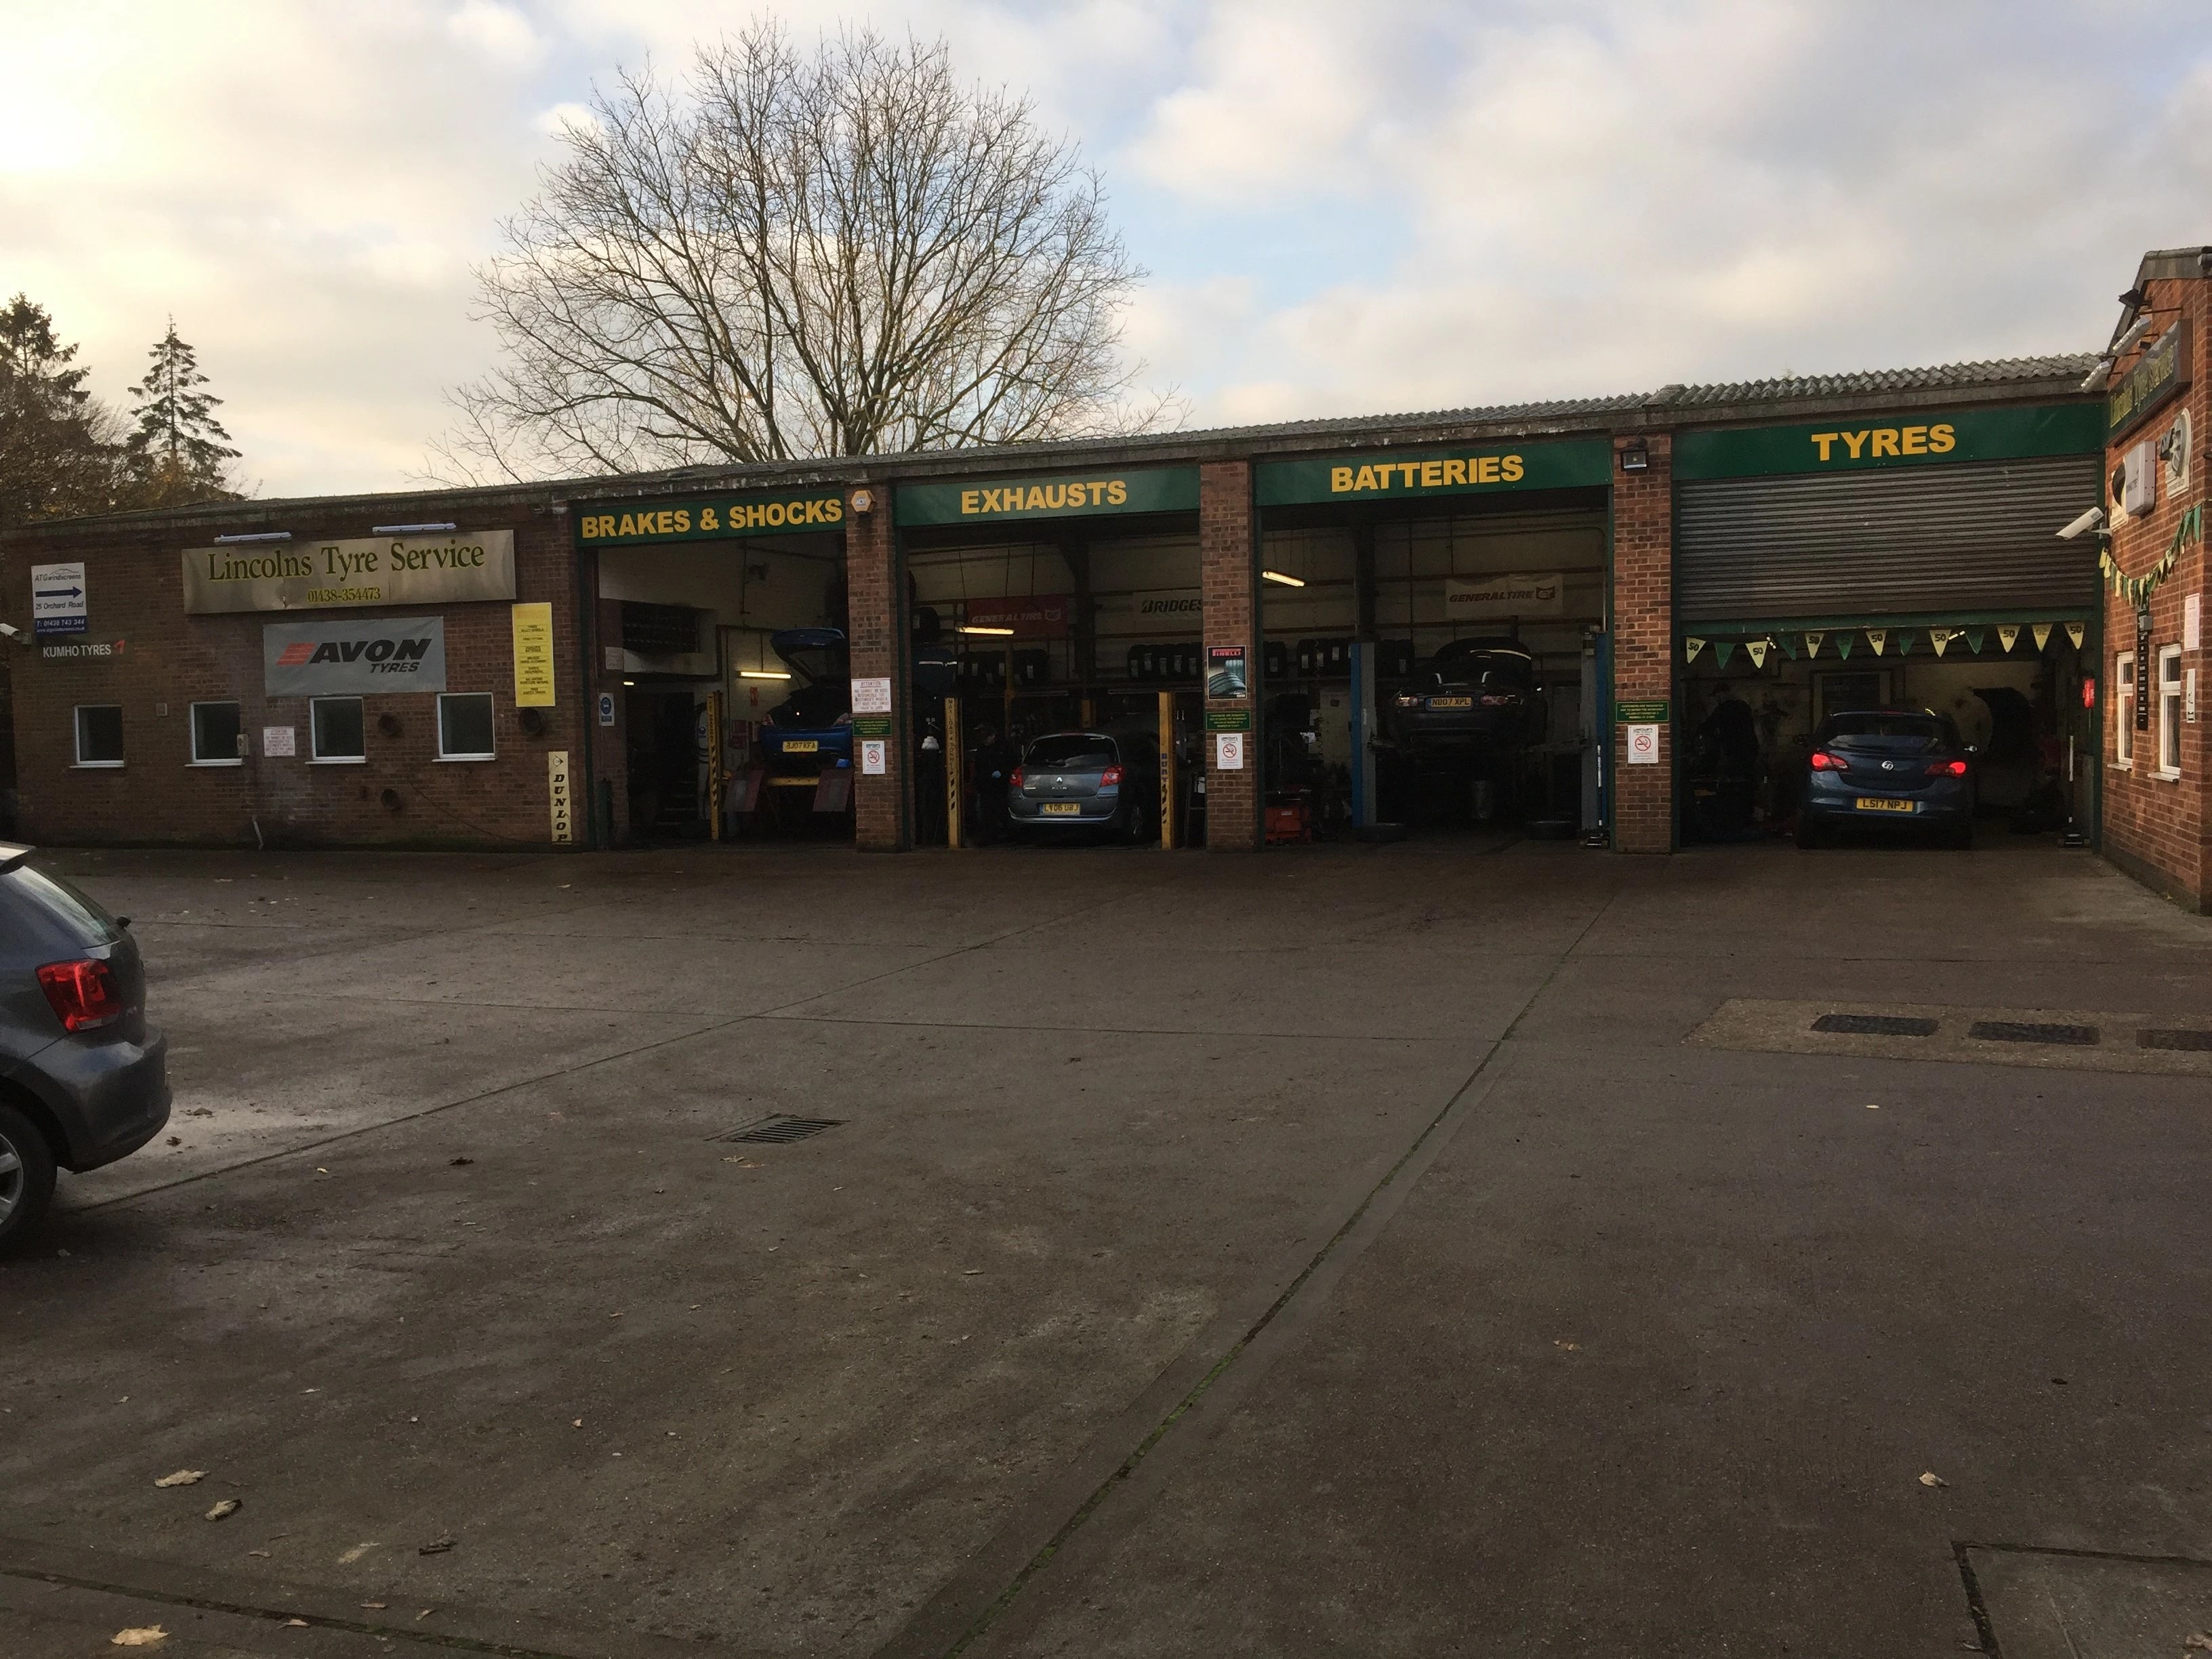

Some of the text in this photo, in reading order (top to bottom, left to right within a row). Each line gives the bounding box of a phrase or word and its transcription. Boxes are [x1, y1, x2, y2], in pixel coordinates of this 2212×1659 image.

[1811, 424, 1956, 461] TYRES
[1331, 455, 1524, 492] BATTERIES
[962, 480, 1126, 514] EXHAUSTS
[582, 499, 842, 537] BRAKES & SHOCKS
[207, 539, 485, 582] Lincolns Tyre Service
[307, 586, 382, 604] 01438-354473
[1449, 592, 1505, 602] GENERAL
[43, 602, 66, 610] Orchard
[68, 600, 84, 609] Road
[972, 613, 1019, 623] GENERAL
[2003, 630, 2015, 638] 50
[2070, 626, 2082, 634] 50
[1872, 633, 1883, 642] 50
[1935, 633, 1946, 642] 50
[43, 643, 111, 658] KUMHO TYRES
[308, 638, 433, 663] AVON
[1687, 642, 1700, 652] 50
[1753, 647, 1763, 655] 50
[370, 662, 420, 674] TYRES
[553, 774, 568, 843] DUNLOP
[1863, 799, 1908, 810] LS17 NPJ
